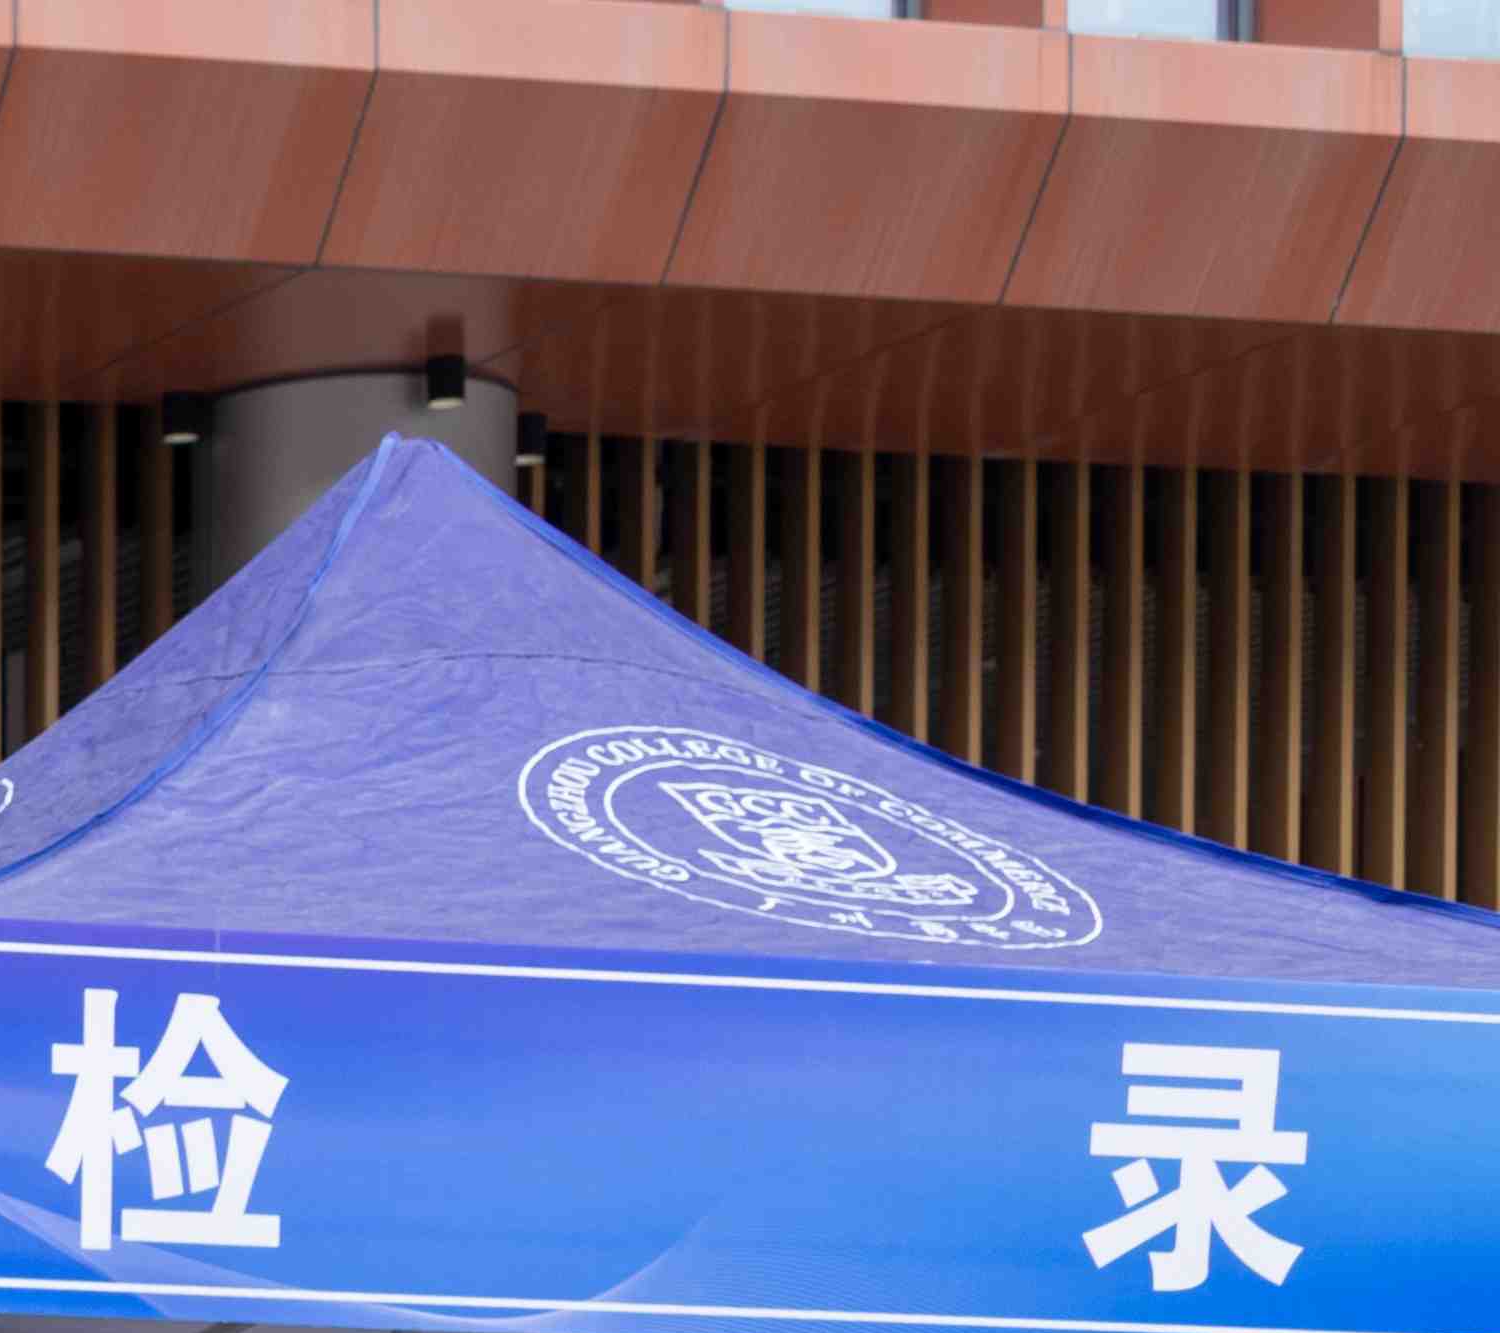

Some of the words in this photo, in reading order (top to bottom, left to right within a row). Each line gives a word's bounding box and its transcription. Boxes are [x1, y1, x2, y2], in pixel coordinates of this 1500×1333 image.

[585, 738, 785, 776] COLLEGE
[547, 757, 690, 882] GUANGZHOU
[696, 790, 832, 826] GCC
